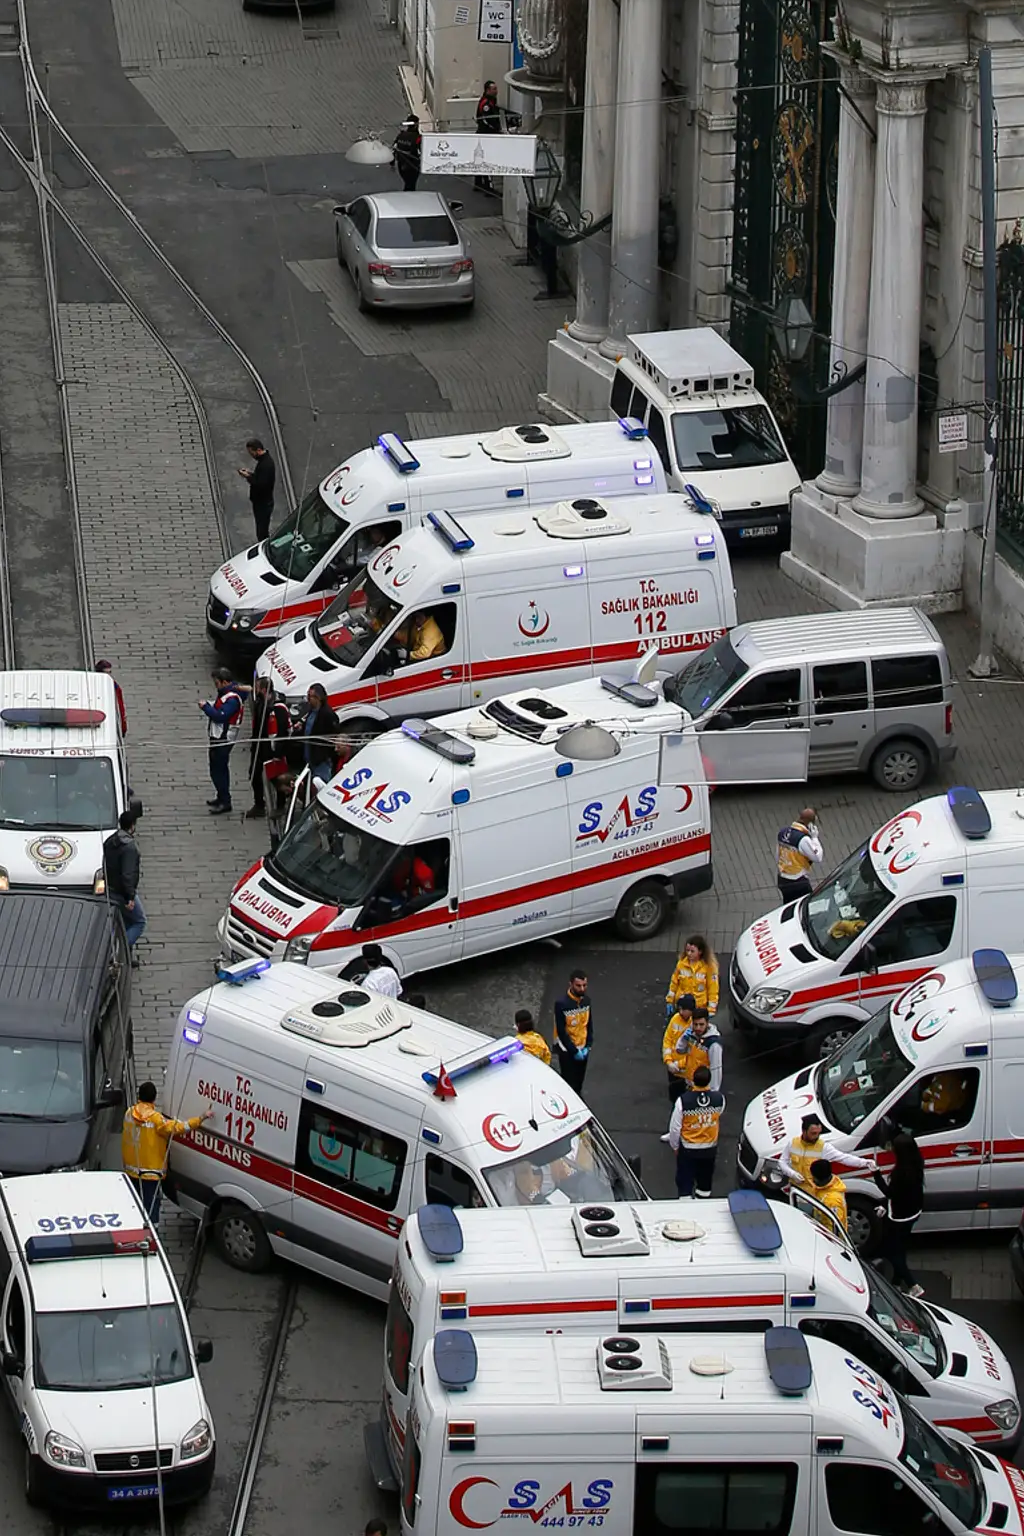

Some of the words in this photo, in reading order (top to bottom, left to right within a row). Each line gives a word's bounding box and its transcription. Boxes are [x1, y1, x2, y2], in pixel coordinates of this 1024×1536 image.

[488, 12, 505, 20] WC
[639, 579, 659, 593] T.C.
[601, 597, 640, 614] SAĞLIK
[643, 588, 699, 610] BAKANLIĞI
[634, 611, 667, 634] 112
[637, 630, 723, 653] AMBULANS
[614, 829, 628, 840] 444
[631, 825, 641, 836] 97
[643, 822, 654, 832] 43
[612, 849, 630, 860] ACİL
[630, 840, 660, 855] YARDIM
[661, 828, 705, 847] AMBULANSI
[236, 1075, 253, 1097] T.C.
[197, 1079, 233, 1108] SAĞLIK
[235, 1096, 288, 1132] BAKANLIĞI
[225, 1111, 256, 1147] 112
[698, 1114, 713, 1123] 112
[493, 1121, 520, 1141] 112
[180, 1130, 252, 1167] BULANS
[38, 1214, 122, 1232] 29456
[111, 1490, 124, 1498] 34
[126, 1488, 135, 1497] A
[541, 1518, 565, 1527] 444
[568, 1516, 585, 1527] 97
[588, 1516, 604, 1526] 43
